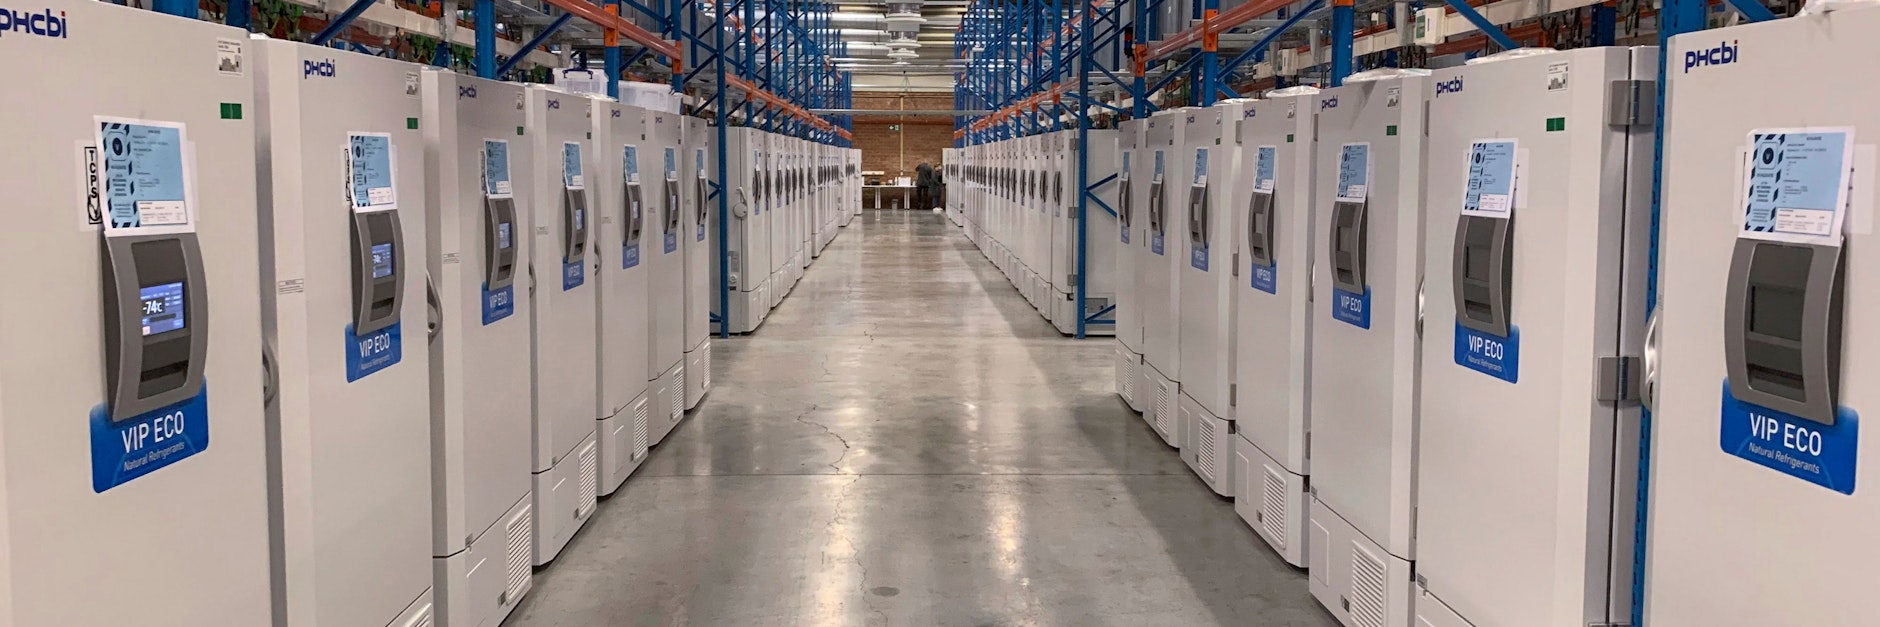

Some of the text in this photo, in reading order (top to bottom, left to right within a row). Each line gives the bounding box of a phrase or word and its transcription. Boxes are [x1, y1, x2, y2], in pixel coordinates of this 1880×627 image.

[359, 332, 390, 359] VIP ECO
[1468, 334, 1504, 361] VIP ECO
[122, 410, 185, 454] VIP ECO
[1749, 412, 1822, 457] VIP ECO
[123, 441, 185, 472] Natural Refrigerants
[1748, 442, 1820, 475] Natural Refrigerants
